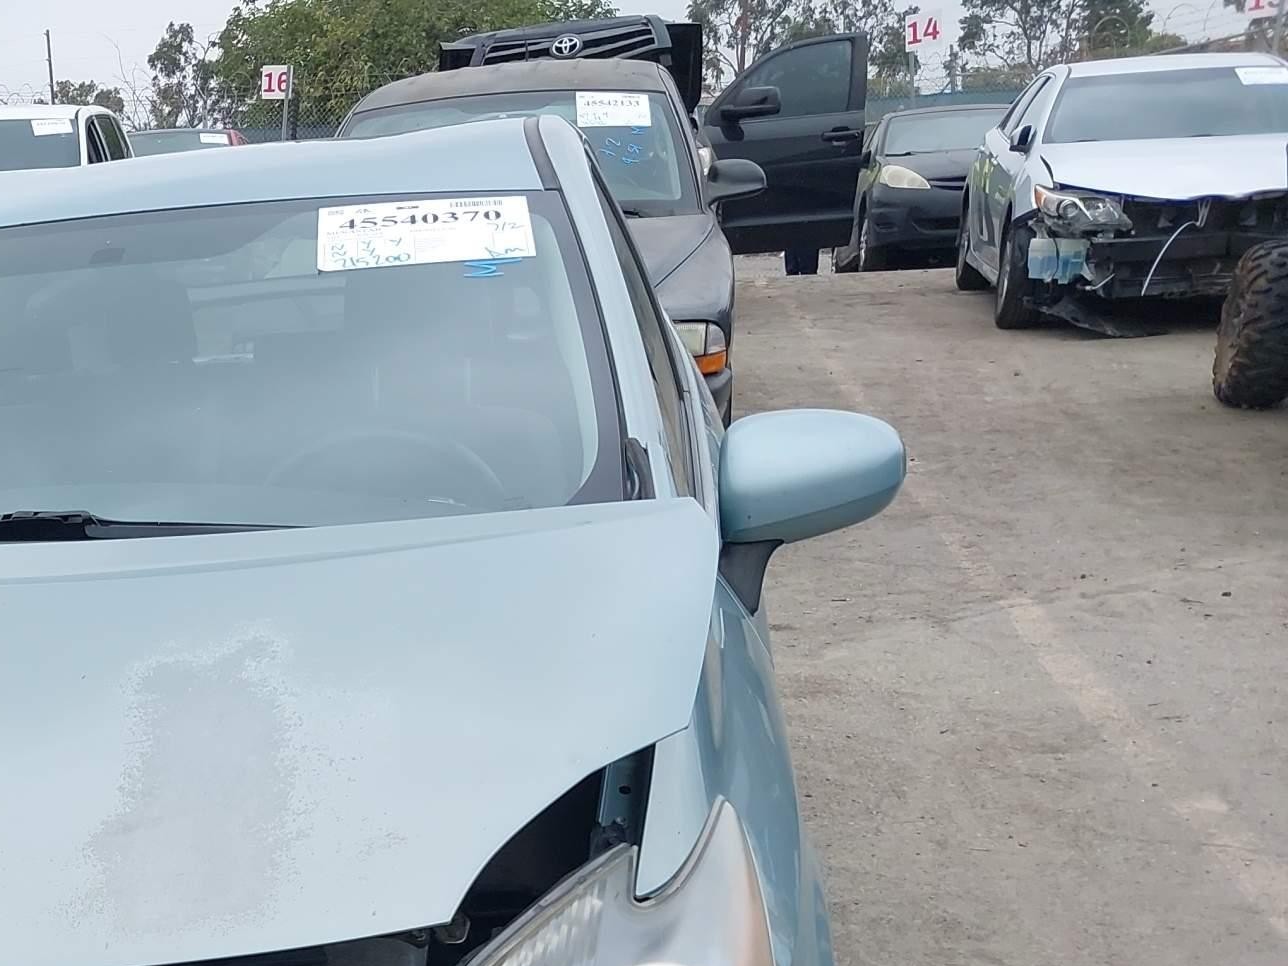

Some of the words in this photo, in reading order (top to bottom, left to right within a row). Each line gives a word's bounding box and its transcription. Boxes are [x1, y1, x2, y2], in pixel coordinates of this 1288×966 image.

[907, 17, 940, 45] 14
[263, 71, 288, 93] 16
[339, 210, 501, 230] 45540370
